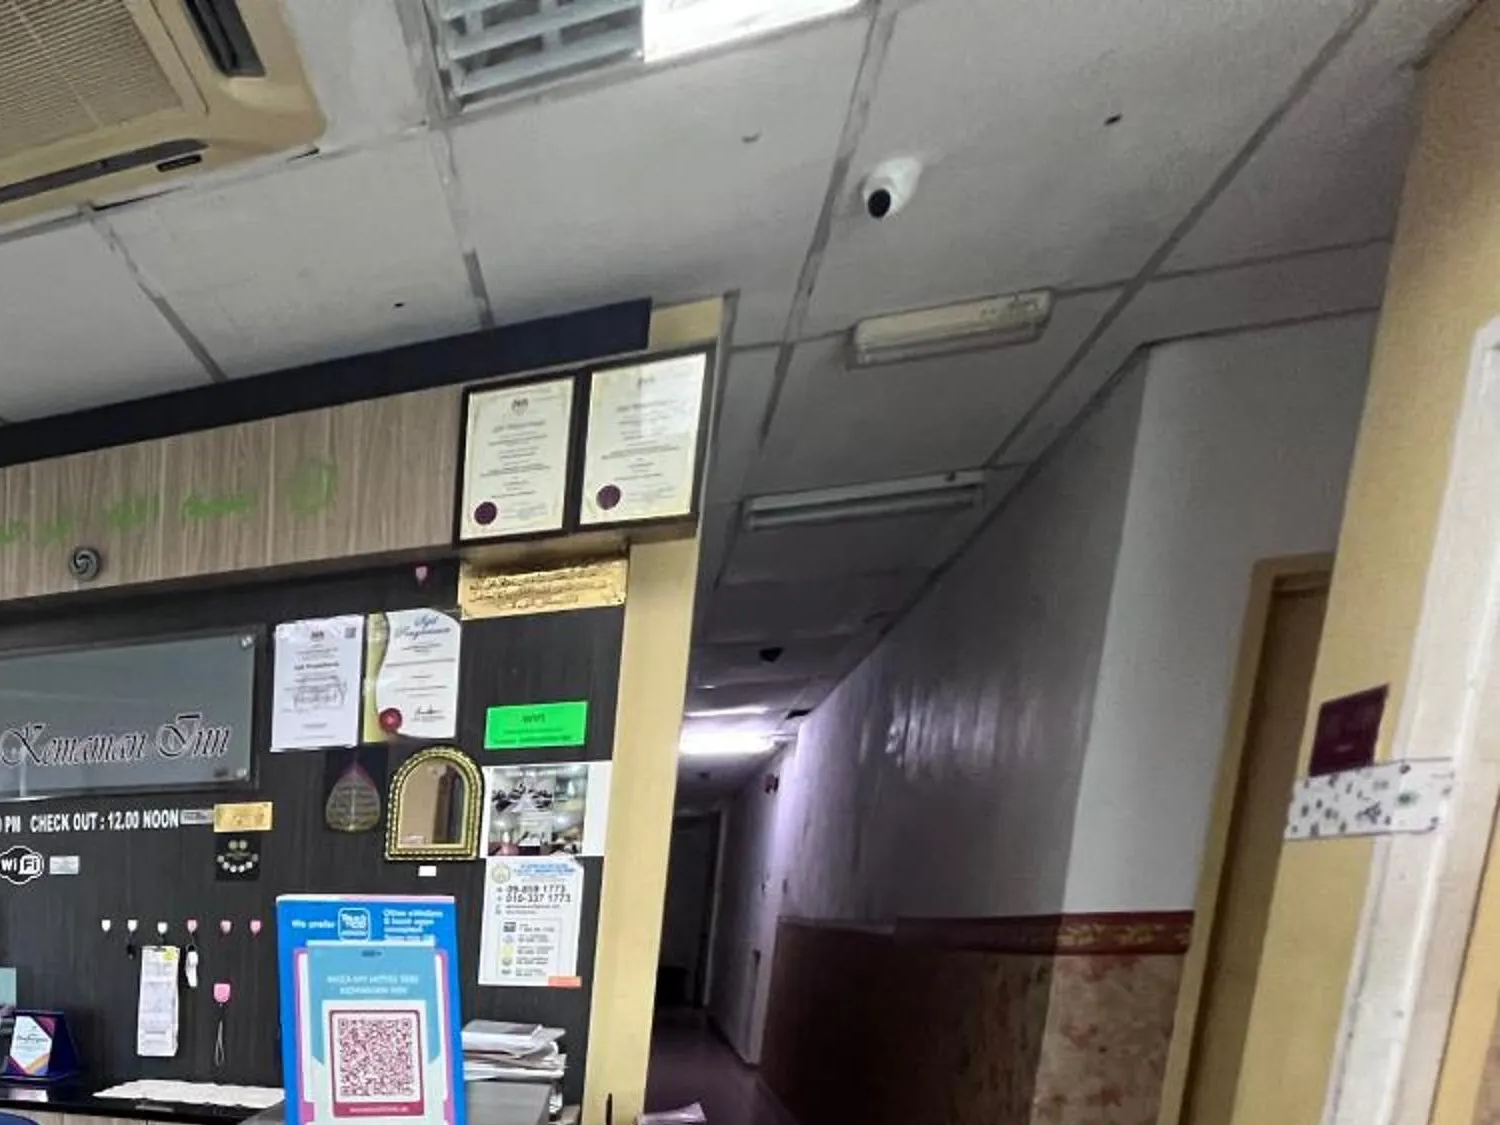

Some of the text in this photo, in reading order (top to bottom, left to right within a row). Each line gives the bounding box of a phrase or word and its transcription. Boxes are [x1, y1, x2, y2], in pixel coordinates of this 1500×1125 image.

[4, 815, 21, 833] PM
[30, 813, 70, 832] CHECK
[73, 811, 99, 831] OUT
[108, 810, 140, 831] 12.00
[143, 808, 179, 828] NOON
